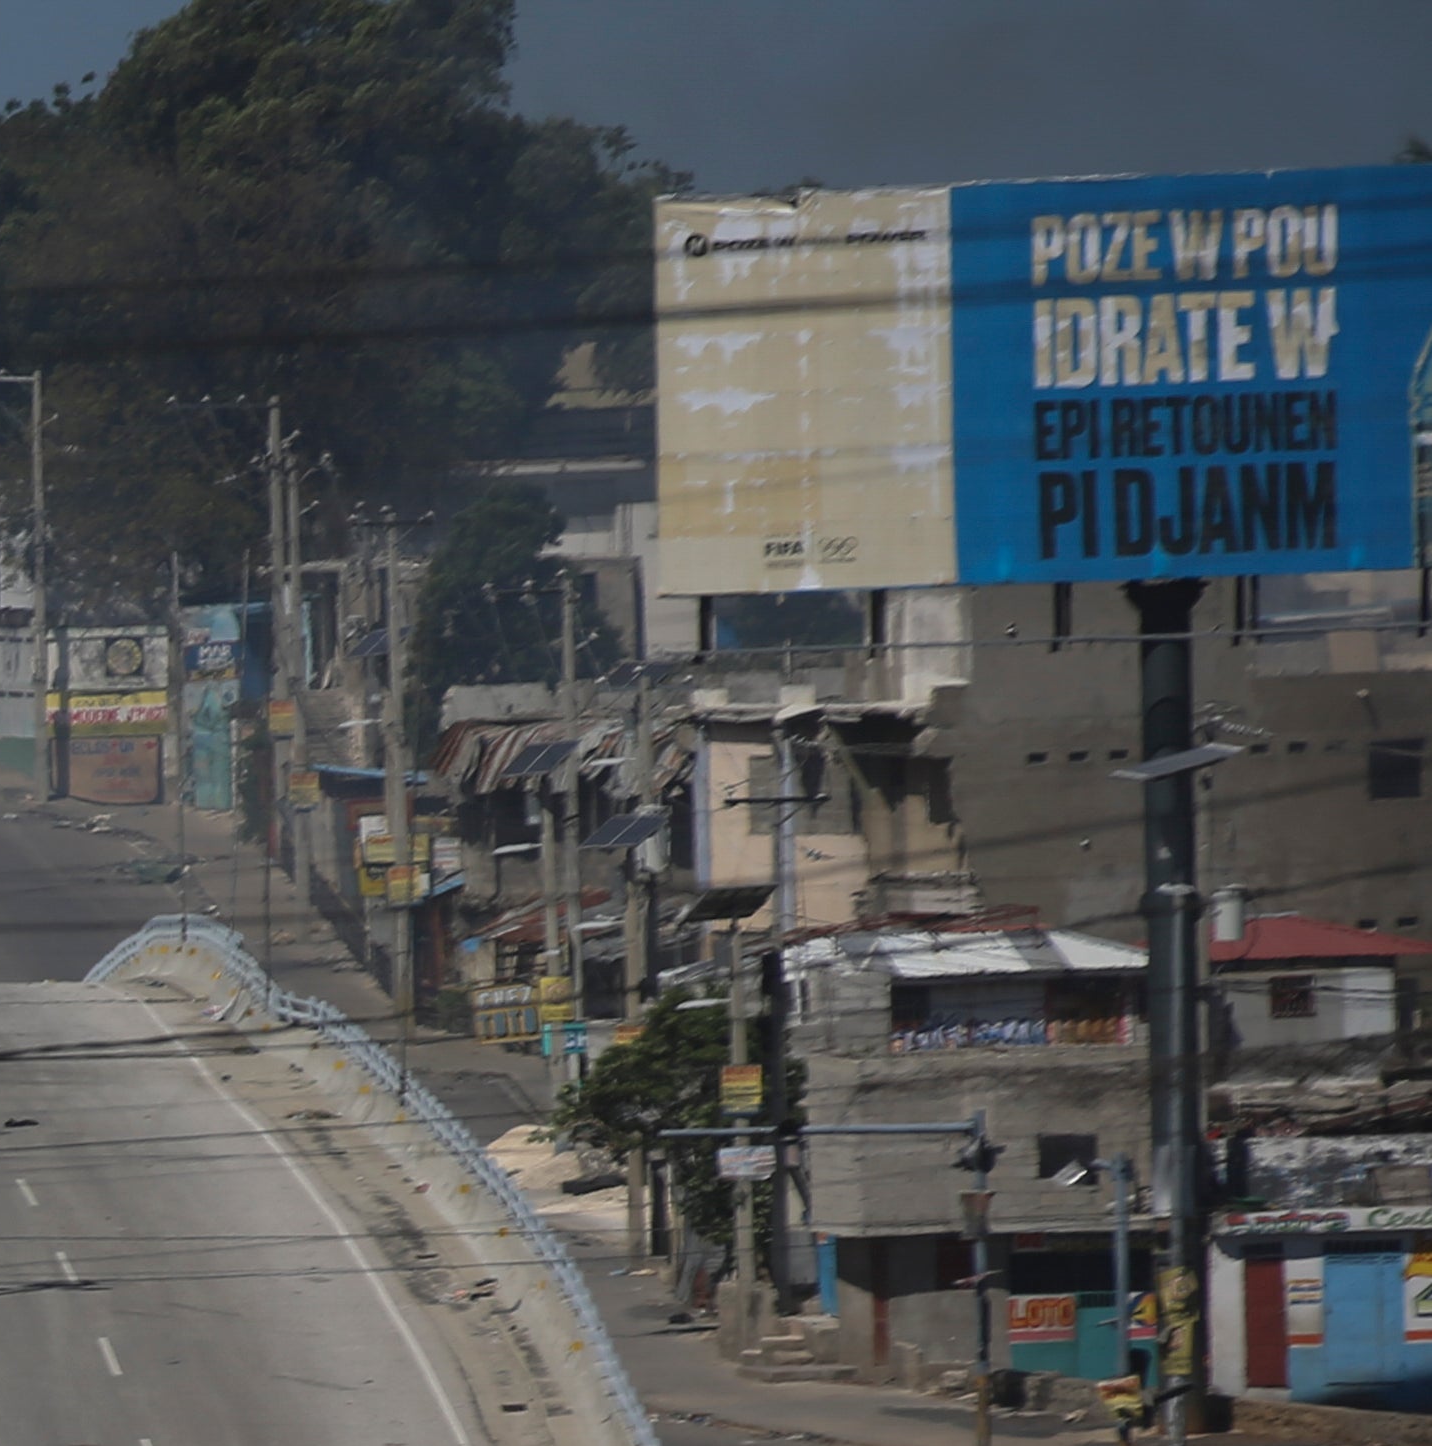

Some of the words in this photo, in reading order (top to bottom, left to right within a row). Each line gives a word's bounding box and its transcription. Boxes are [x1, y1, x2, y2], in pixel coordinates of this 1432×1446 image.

[1031, 210, 1162, 287] POZE
[1168, 209, 1224, 281] W
[1233, 203, 1338, 279] POU
[1033, 290, 1255, 390] IDRATE
[1264, 286, 1340, 380] W
[1033, 398, 1101, 462] EPI
[1111, 389, 1338, 458] RETOUNEN
[1039, 469, 1101, 560] PI
[1114, 460, 1338, 557] DJANM
[763, 541, 804, 558] FIFA
[1009, 1297, 1075, 1328] LOTO
